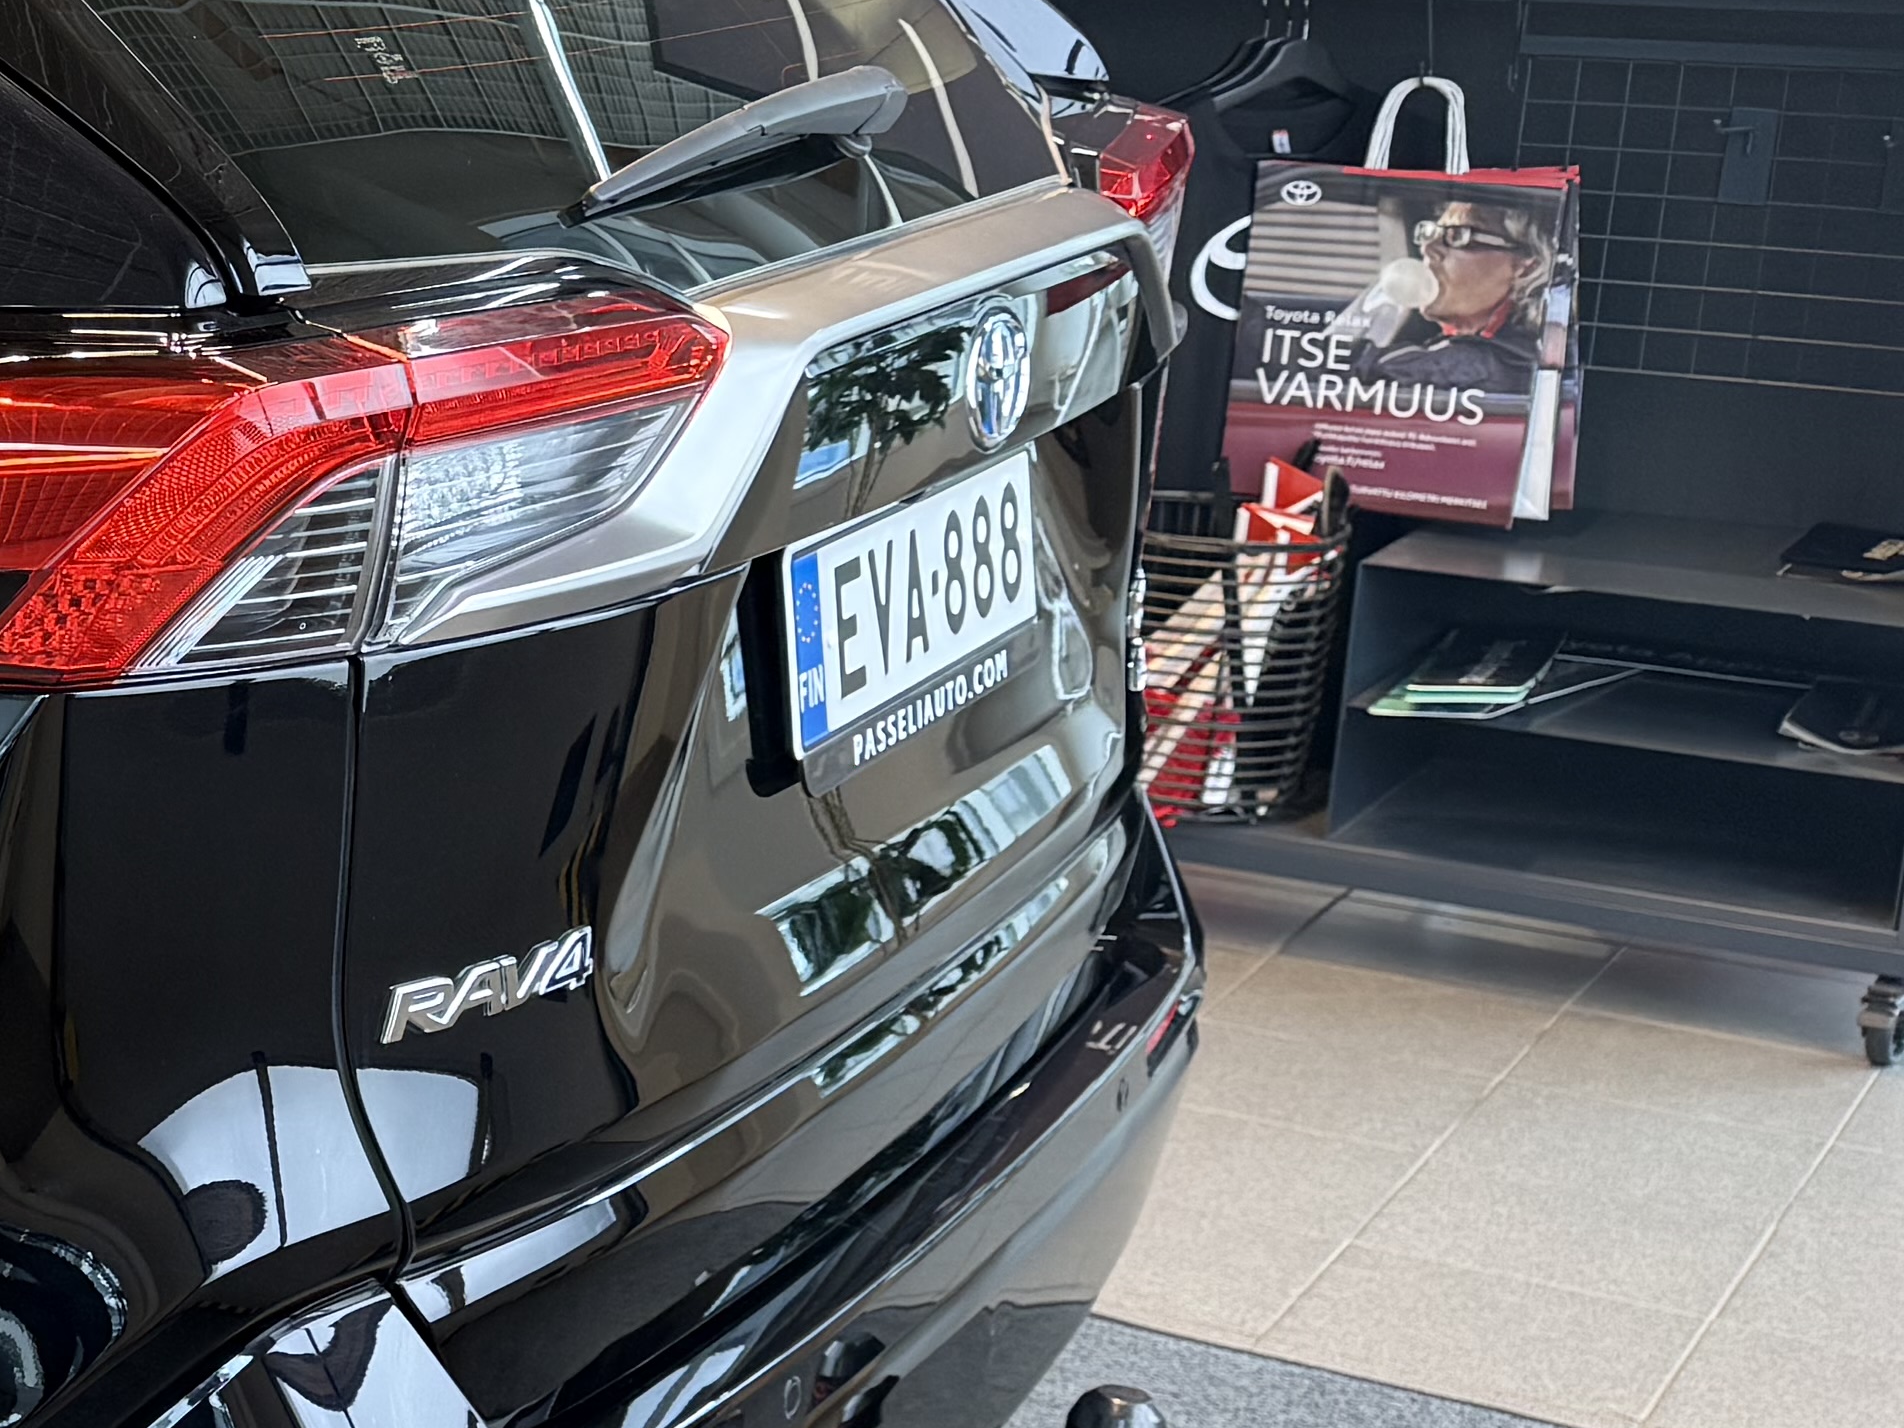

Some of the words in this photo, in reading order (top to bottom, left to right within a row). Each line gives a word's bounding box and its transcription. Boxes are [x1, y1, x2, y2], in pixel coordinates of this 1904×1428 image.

[1261, 328, 1354, 371] ITSE
[1255, 368, 1486, 425] VARMUUS
[834, 481, 1022, 700] EVA-888
[798, 664, 826, 713] FIN
[852, 649, 1009, 766] PASSELIAUTO.COM
[380, 925, 594, 1045] RAV4
